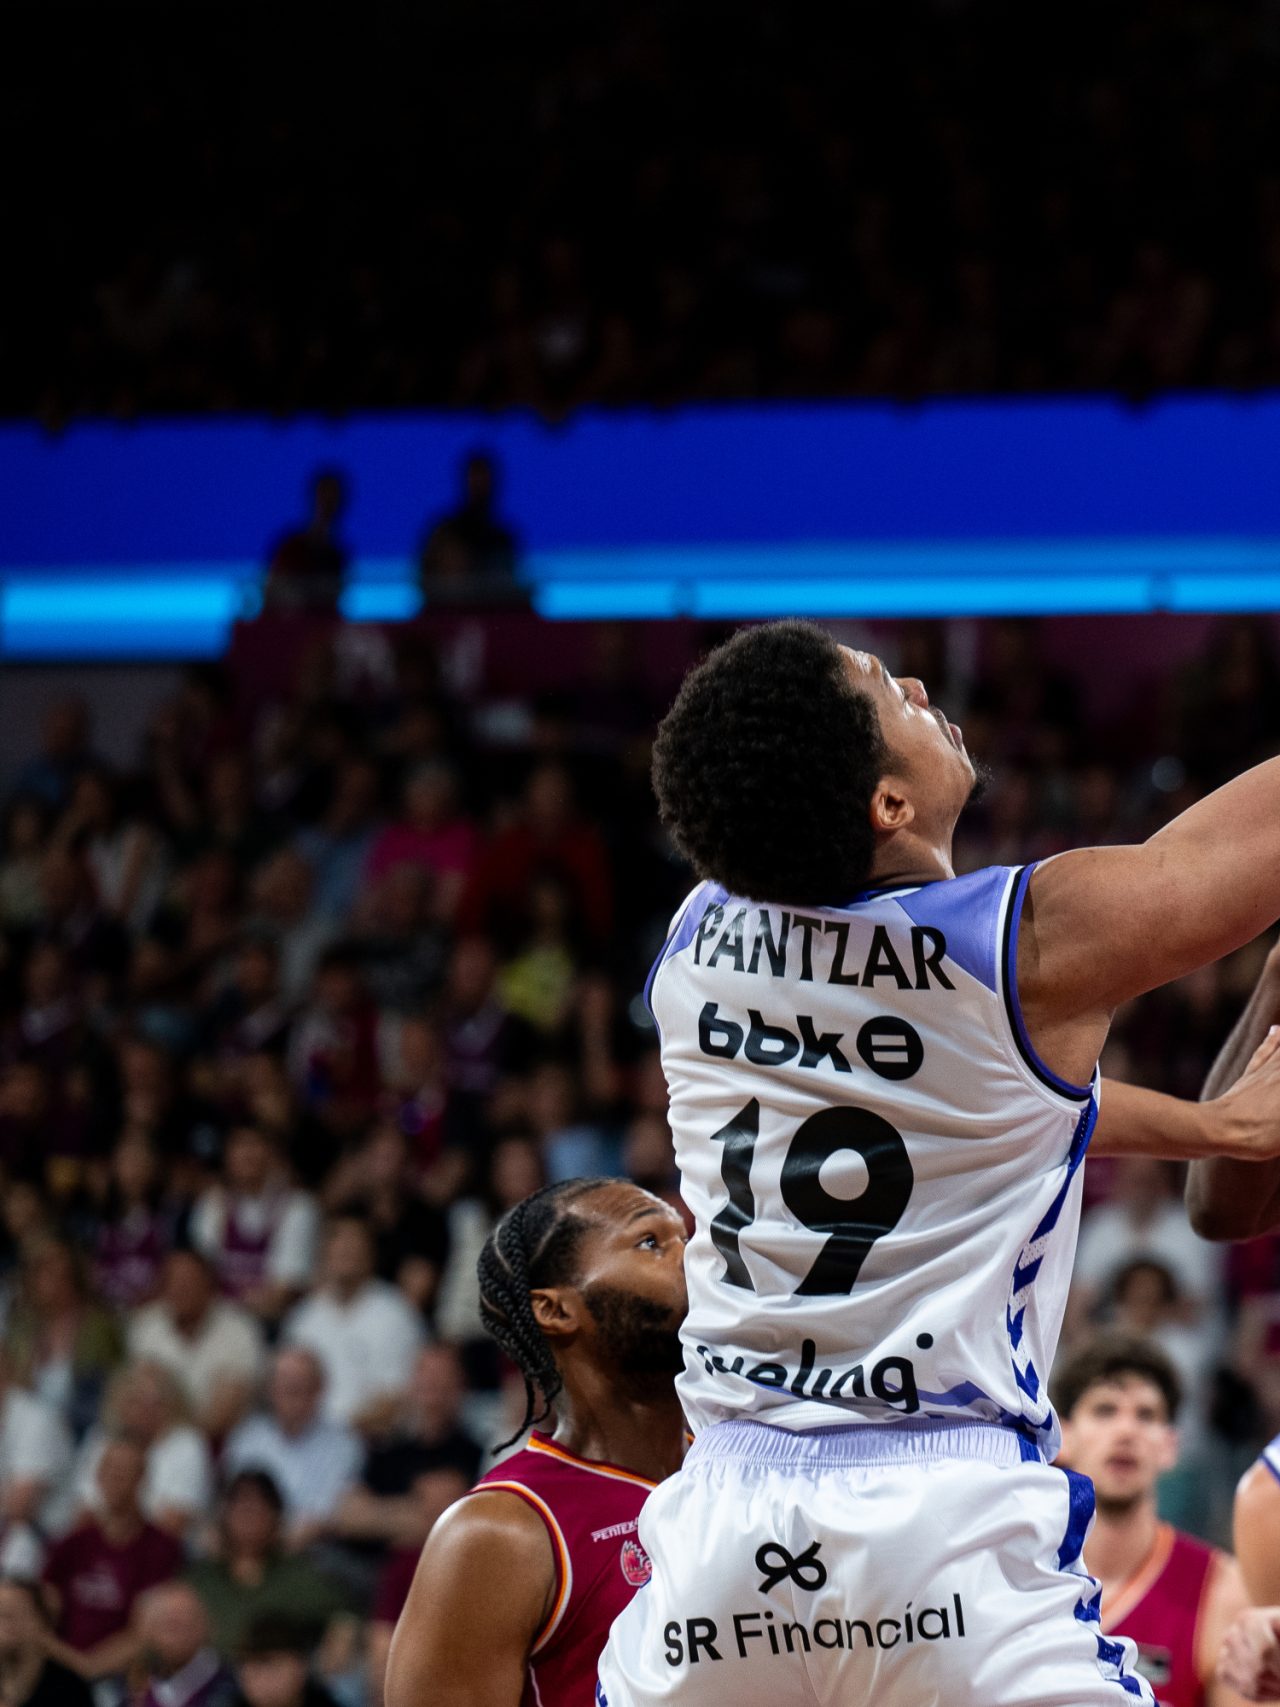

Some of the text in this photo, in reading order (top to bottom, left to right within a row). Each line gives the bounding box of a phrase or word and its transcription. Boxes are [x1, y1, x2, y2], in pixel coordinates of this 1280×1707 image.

[693, 901, 957, 991] PANTZAR
[698, 1002, 853, 1073] bbk
[710, 1096, 914, 1297] 19
[663, 1592, 966, 1668] SR Financial
